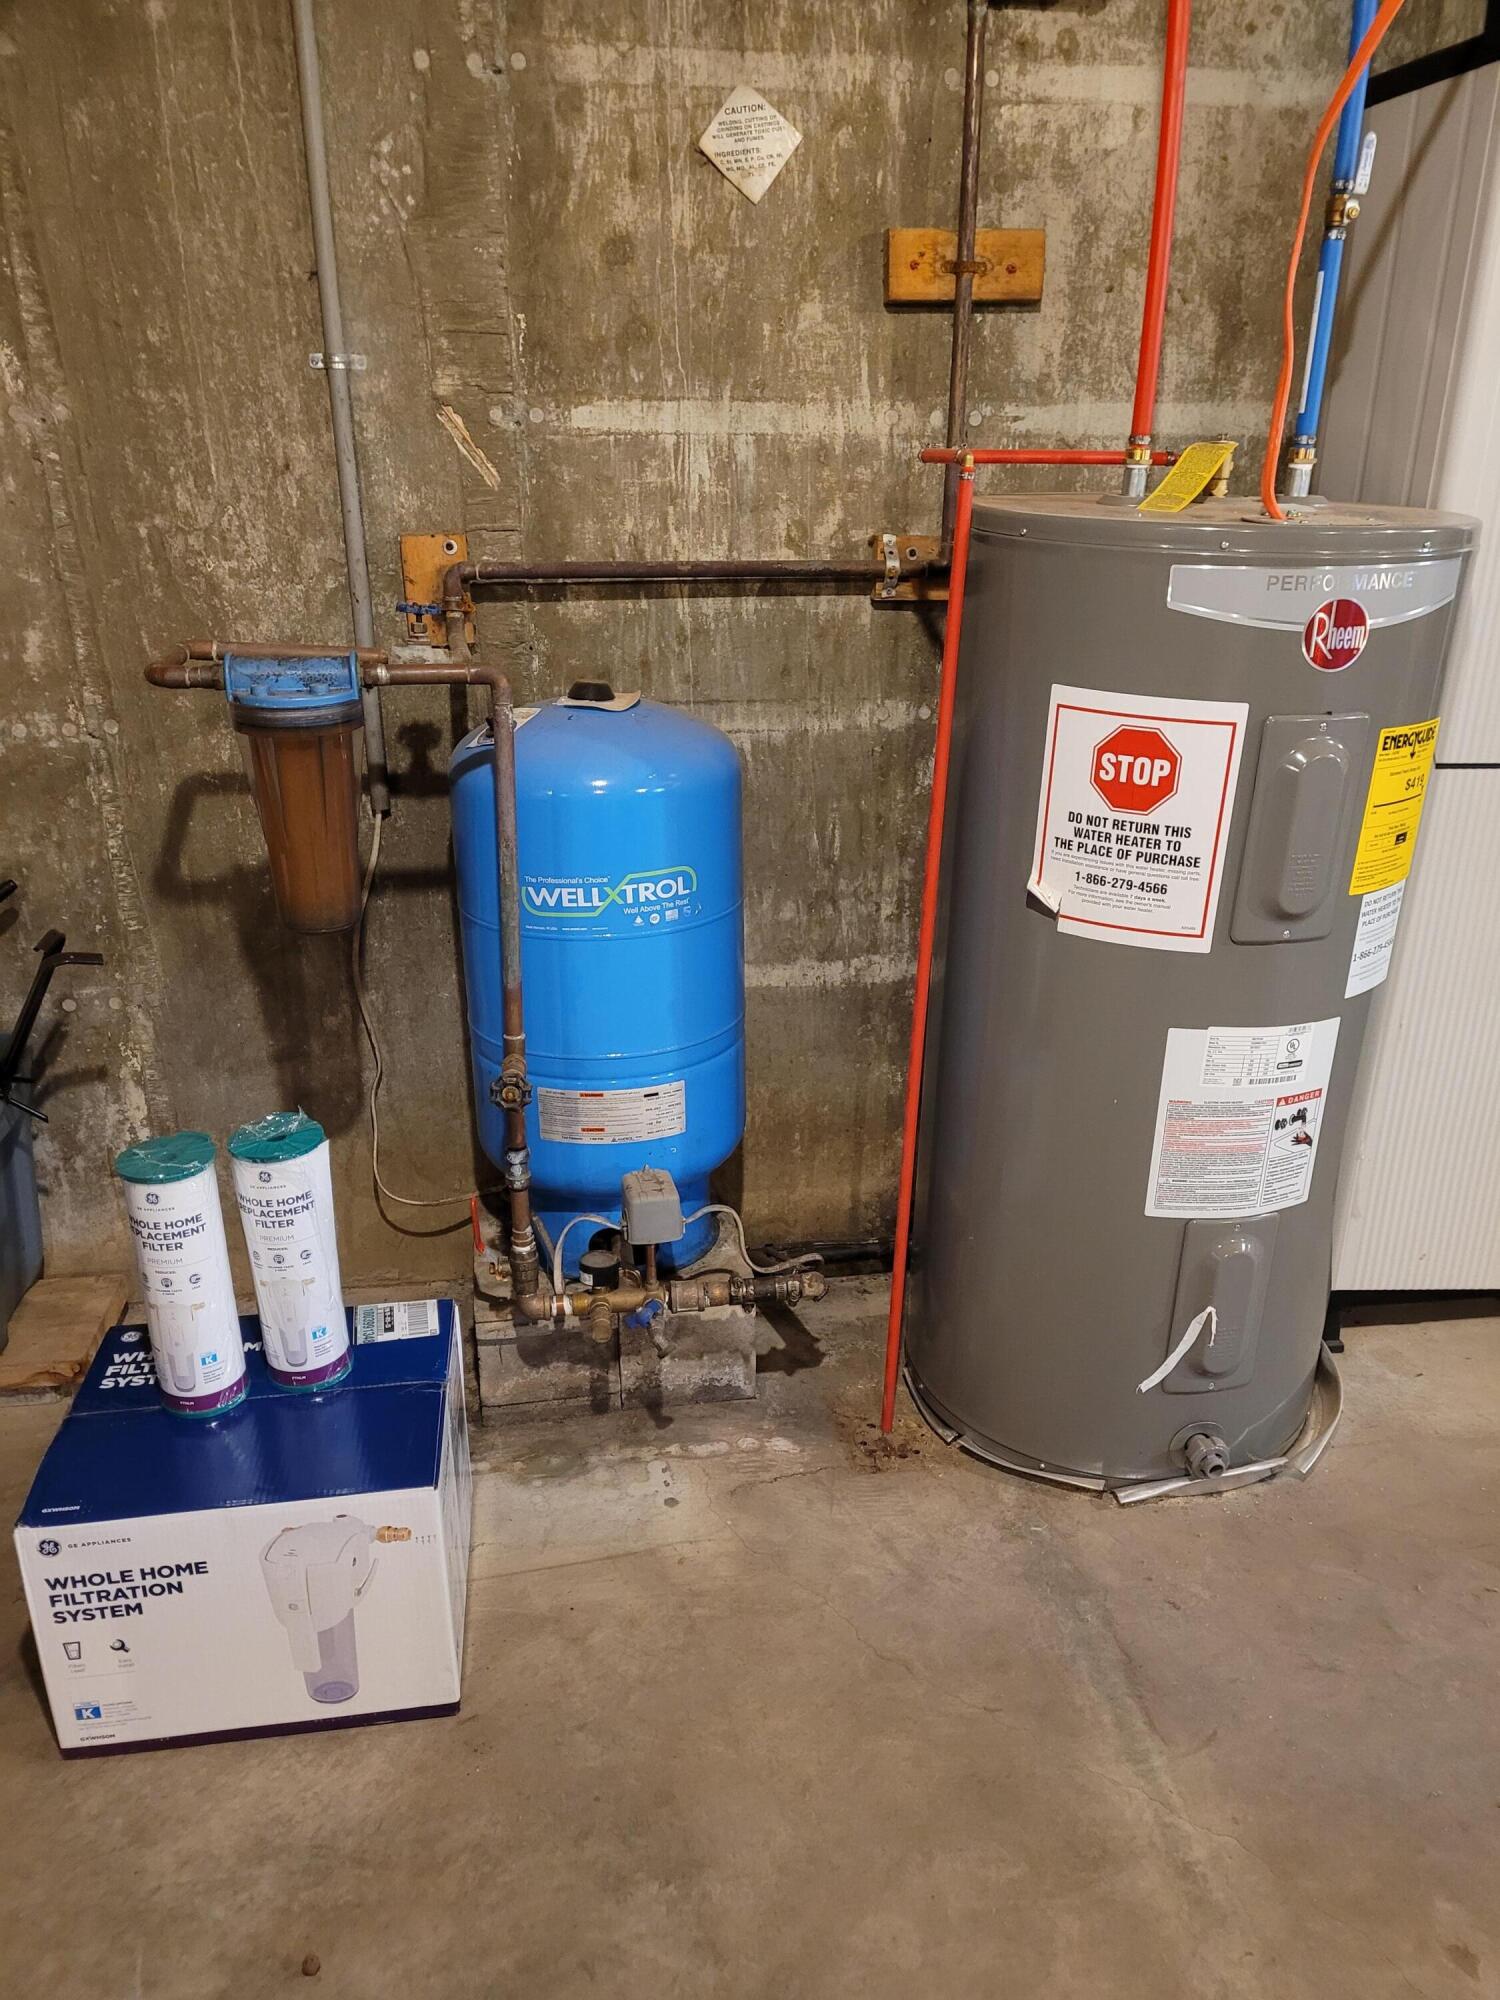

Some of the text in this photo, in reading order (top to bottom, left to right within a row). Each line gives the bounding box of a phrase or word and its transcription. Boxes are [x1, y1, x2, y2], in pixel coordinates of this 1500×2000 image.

[724, 104, 766, 115] CAUTION:
[744, 115, 768, 124] CUTTING
[716, 125, 743, 133] GRINDING
[725, 130, 753, 138] GENERATE
[754, 127, 770, 135] TOXIC
[1266, 571, 1413, 592] PERFOMANCE
[1309, 601, 1365, 659] Rheem
[1099, 752, 1171, 787] STOP
[1068, 811, 1193, 840] DO NOT RETURN THIS
[1074, 826, 1182, 853] WATER HEATER TO
[1054, 836, 1201, 869] THE PLACE OF PURCHASE
[1071, 854, 1099, 865] experiencing
[1061, 857, 1085, 866] installation
[1085, 863, 1109, 871] assistance
[1146, 871, 1171, 880] questions
[524, 875, 537, 883] The
[537, 876, 583, 884] Professional's
[1075, 871, 1168, 895] 1-866-279-4566
[1081, 898, 1101, 906] provided
[1134, 894, 1147, 902] days
[623, 898, 690, 915] Well Above The Rest
[1287, 1090, 1320, 1104] DANGER
[277, 1190, 313, 1207] HOME
[164, 1213, 203, 1230] HOME
[255, 1218, 295, 1229] FILTER
[259, 1234, 295, 1242] PREMIUM
[142, 1241, 184, 1252] FILTER
[147, 1257, 184, 1265] PREMIUM
[98, 1374, 157, 1389] SYST
[81, 1537, 132, 1548] APPLIANCES
[44, 1561, 209, 1591] WHOLE HOME
[49, 1581, 183, 1608] FILTRATION
[53, 1602, 144, 1624] SYSTEM
